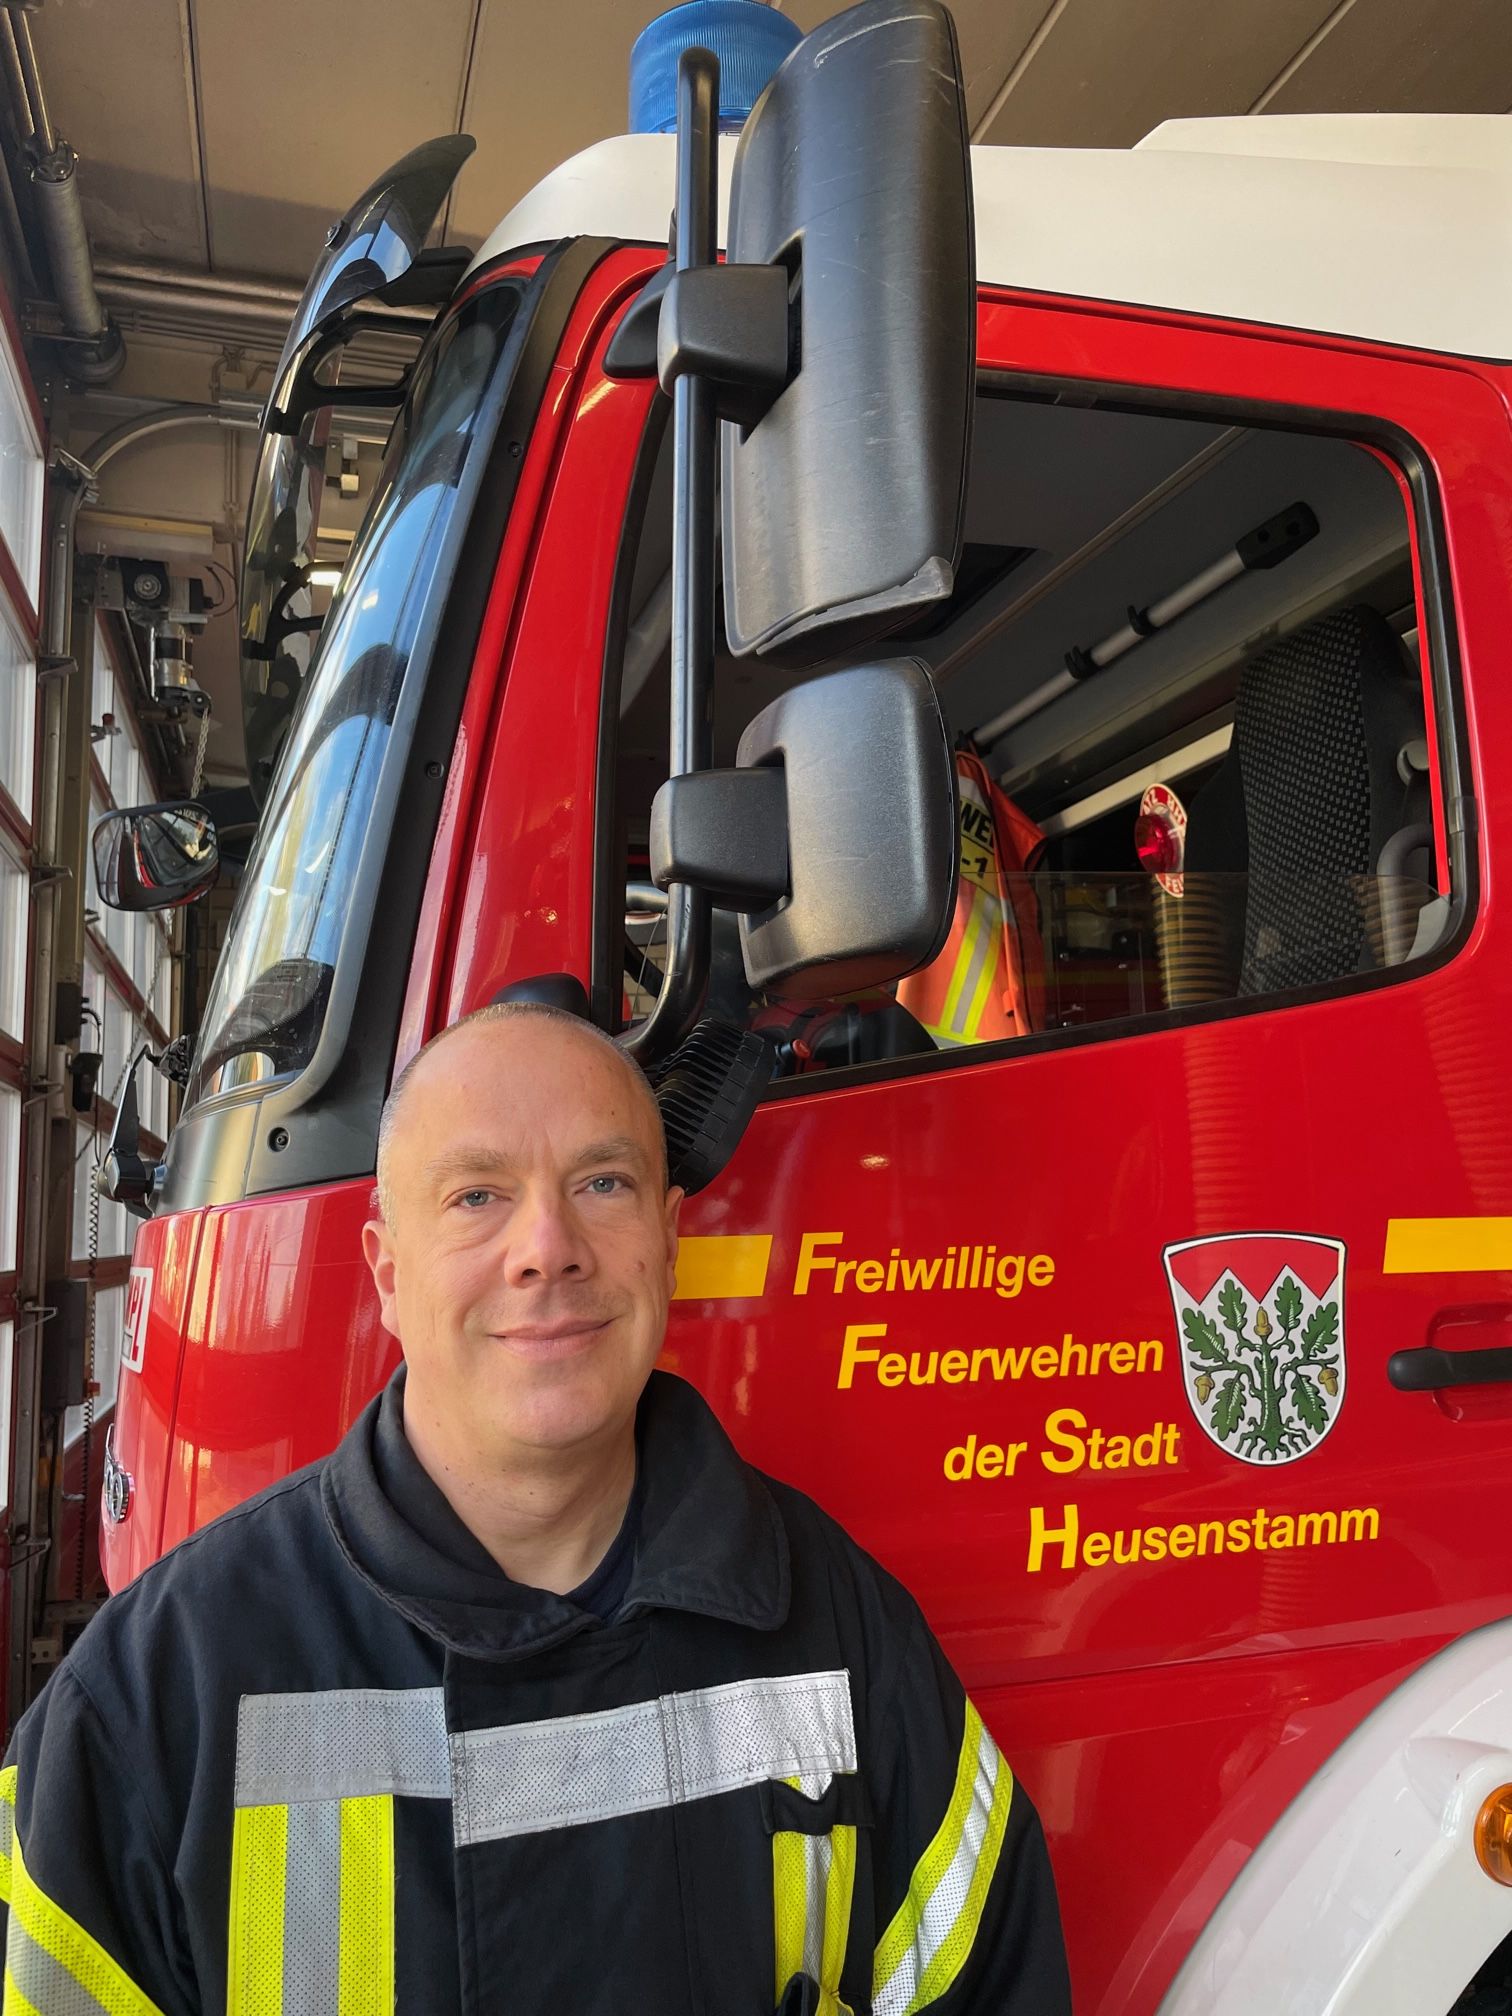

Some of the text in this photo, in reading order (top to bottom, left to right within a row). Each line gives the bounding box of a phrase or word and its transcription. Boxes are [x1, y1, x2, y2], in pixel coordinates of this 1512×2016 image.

[793, 1231, 1056, 1298] Freiwillige
[837, 1323, 1164, 1389] Feuerwehren
[943, 1408, 1181, 1481] der Stadt
[1026, 1504, 1380, 1573] Heusenstamm
